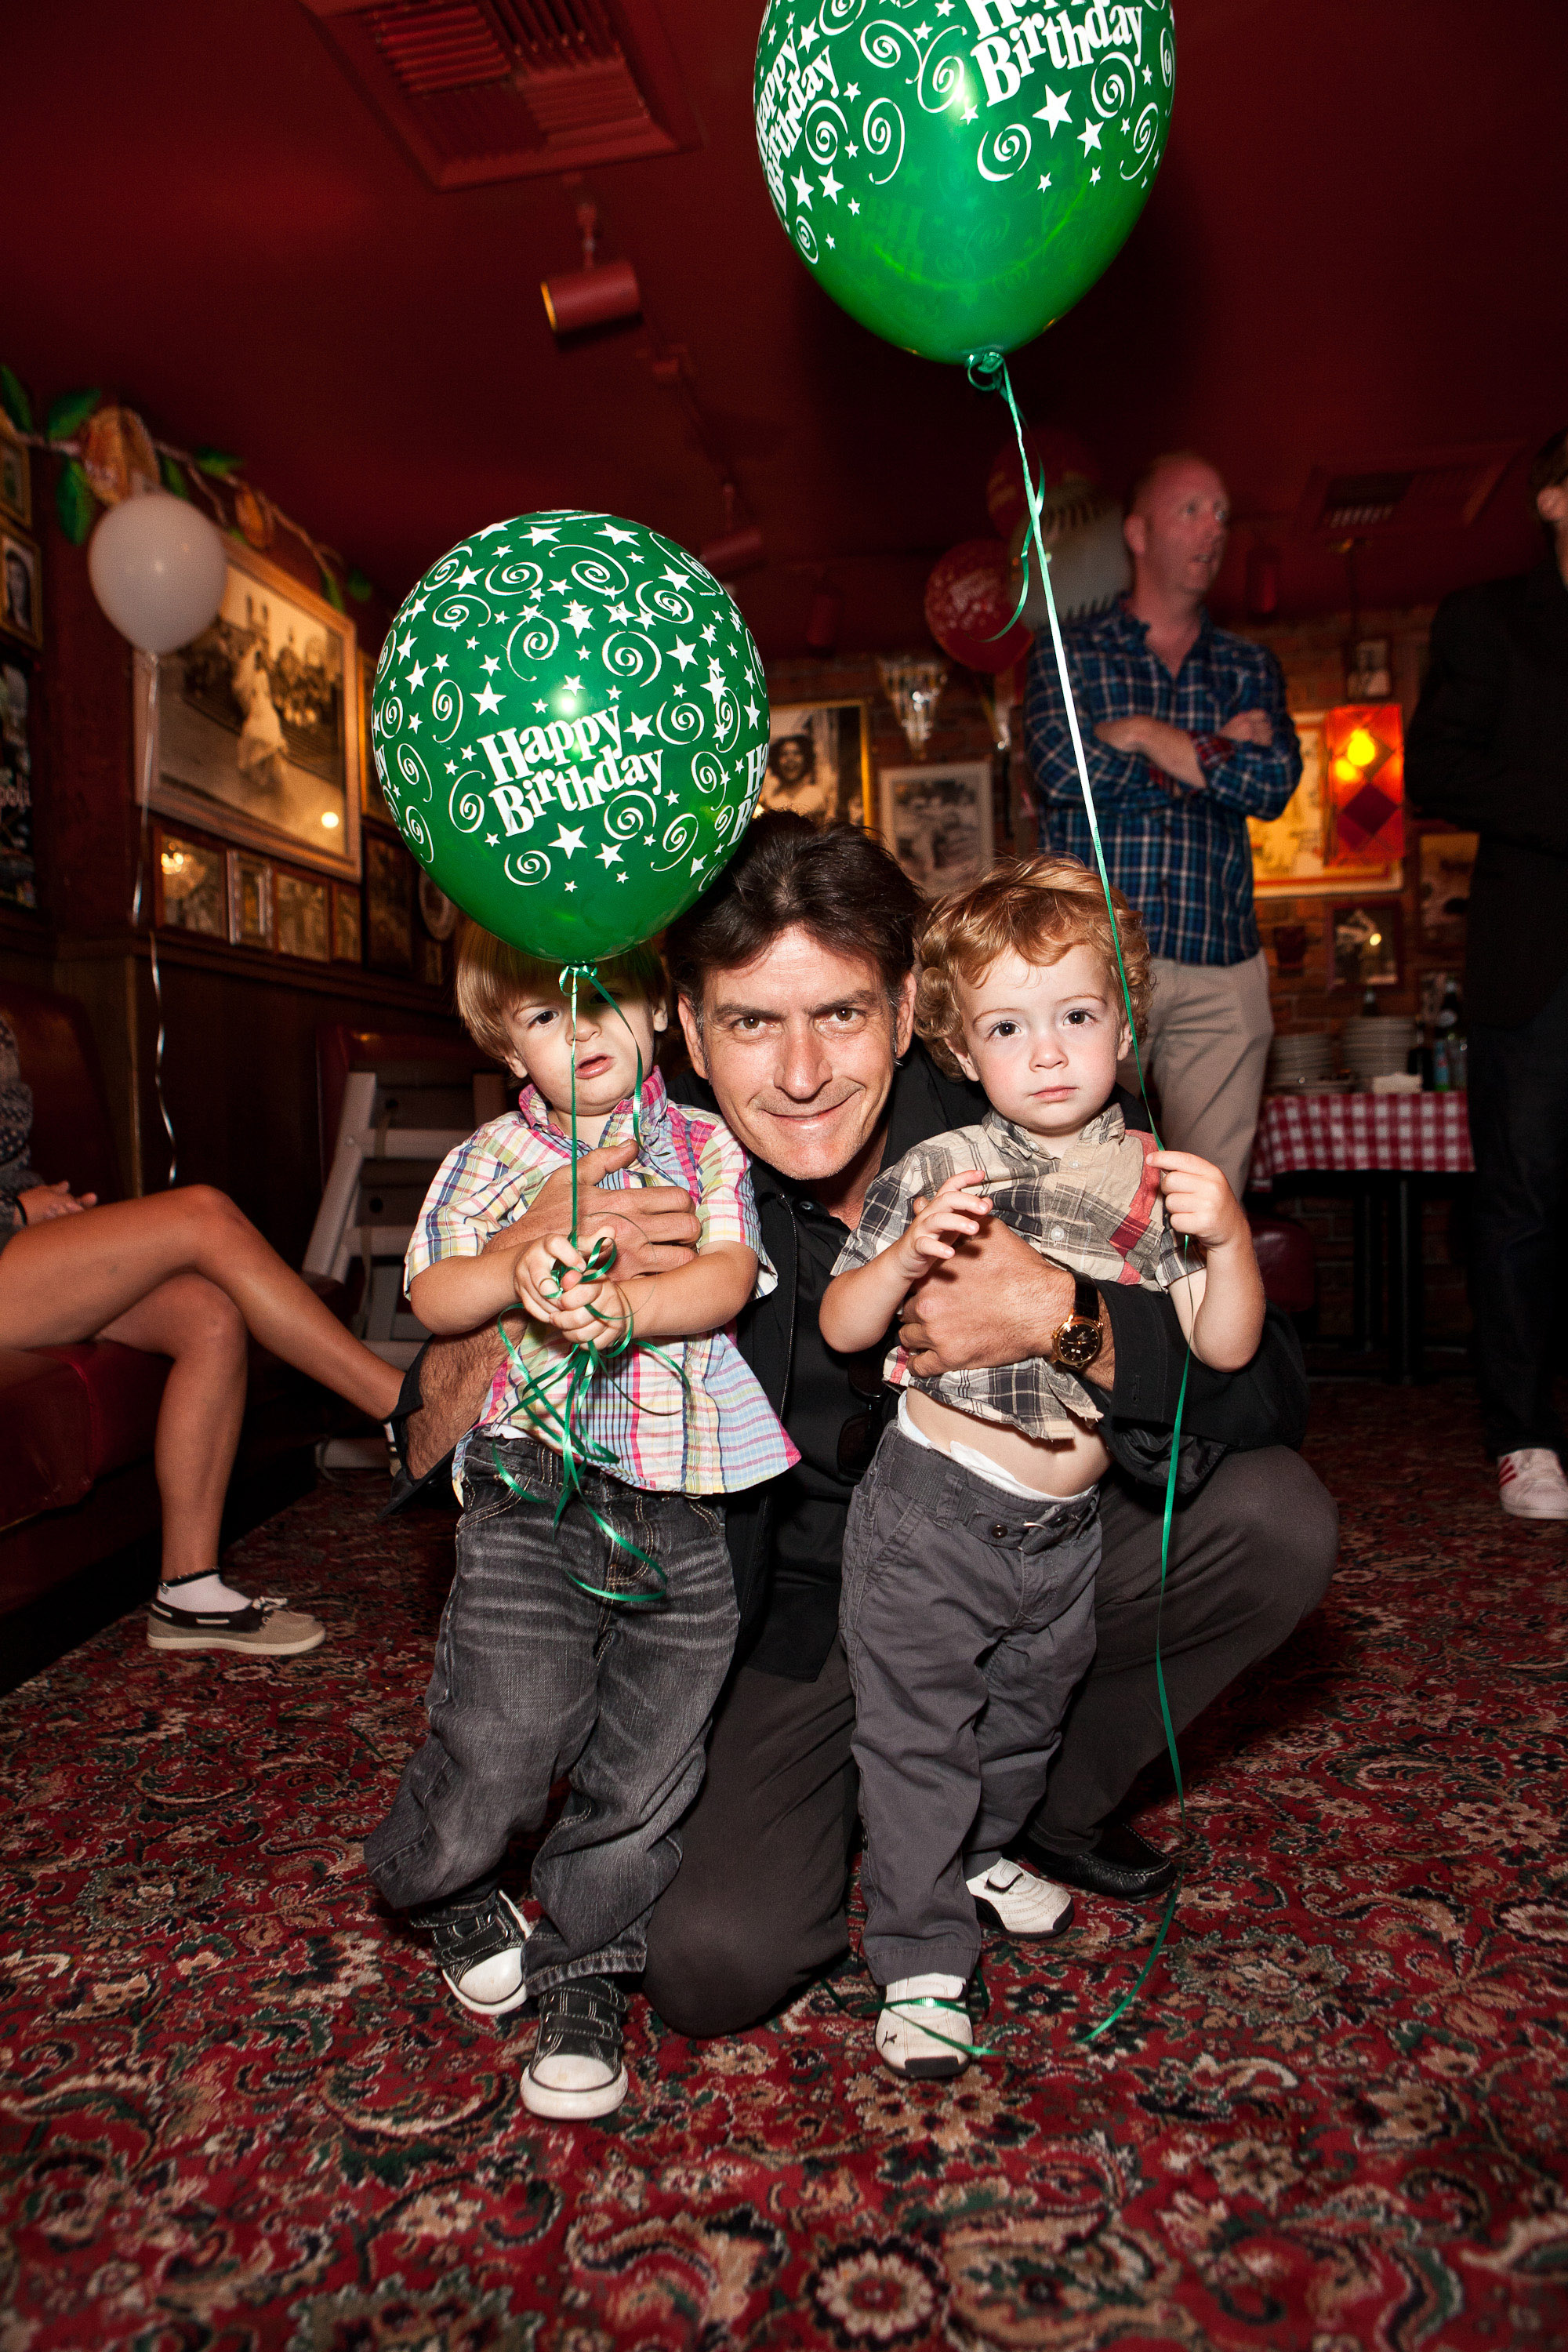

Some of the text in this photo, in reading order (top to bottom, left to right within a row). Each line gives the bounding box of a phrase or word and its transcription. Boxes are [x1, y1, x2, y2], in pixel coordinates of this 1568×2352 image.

[756, 27, 800, 171] Happy
[970, 0, 1142, 107] Birthday
[768, 45, 839, 217] Birthday
[477, 705, 622, 786] Happy
[488, 744, 663, 837] Birthday
